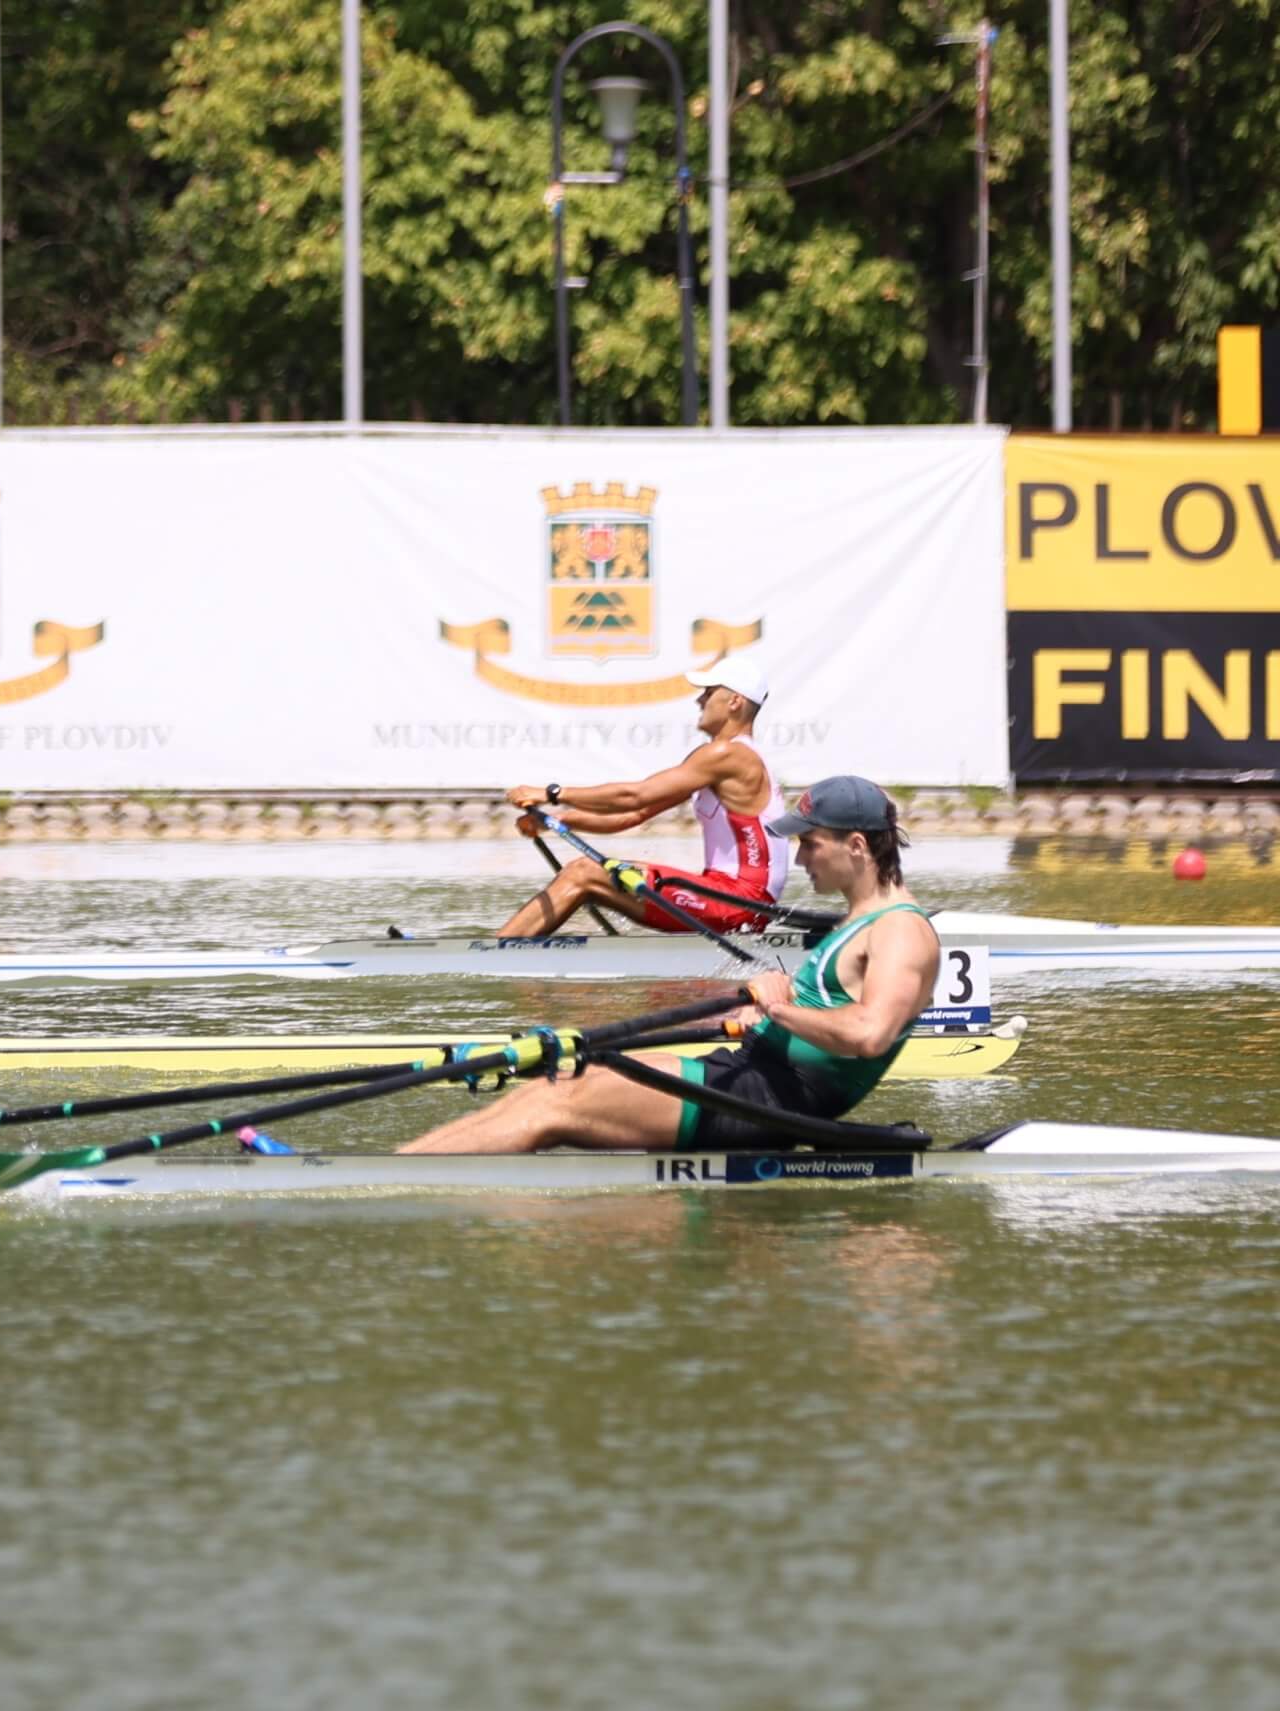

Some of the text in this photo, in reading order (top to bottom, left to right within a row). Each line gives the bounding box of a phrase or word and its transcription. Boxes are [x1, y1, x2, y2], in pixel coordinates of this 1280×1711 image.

[23, 725, 174, 751] PLOVDIV
[372, 722, 833, 748] MUNICIPALITY OF PVDIV
[948, 949, 973, 1004] 3
[655, 1159, 875, 1182] IRL world rowing
